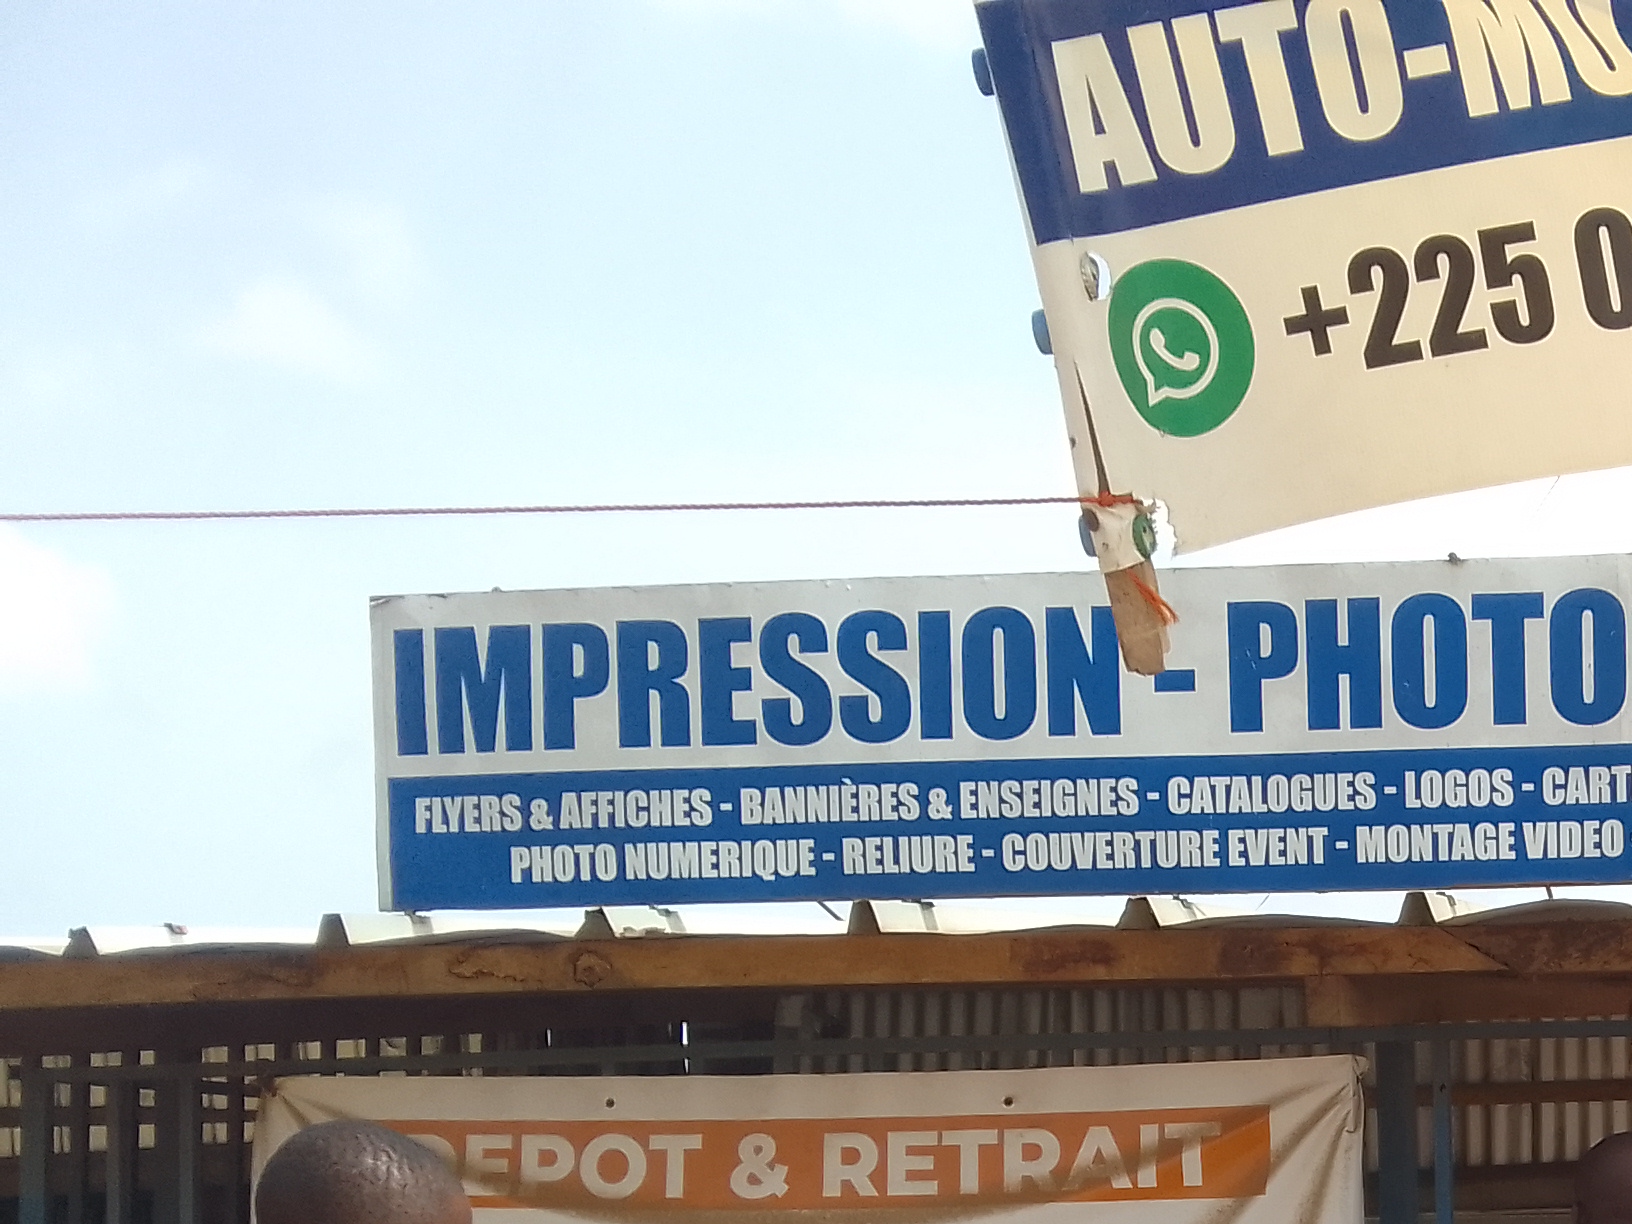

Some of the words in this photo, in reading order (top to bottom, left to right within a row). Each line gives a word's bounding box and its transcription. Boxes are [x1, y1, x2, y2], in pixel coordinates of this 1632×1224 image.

[1283, 221, 1556, 370] +225
[393, 606, 1121, 757] IMPRESSION
[414, 792, 524, 835] FLYERS
[528, 797, 555, 831] &
[558, 787, 714, 830] AFFICHES
[739, 777, 921, 826] BANNIÈRES
[926, 786, 954, 821] &
[958, 776, 1140, 820] ENSEIGNES
[1166, 770, 1378, 816] CATALOGUES
[1403, 767, 1515, 810] LOGOS
[509, 842, 618, 884] PHOTO
[623, 838, 817, 882] NUMERIQUE
[841, 833, 977, 876] RELIURE
[1001, 828, 1222, 873] COUVERTURE
[1226, 825, 1330, 868] EVENT
[1355, 821, 1518, 865] MONTAGE
[1520, 818, 1625, 861] VIDEO
[730, 1133, 790, 1199] &
[822, 1122, 1223, 1198] RETRAIT
